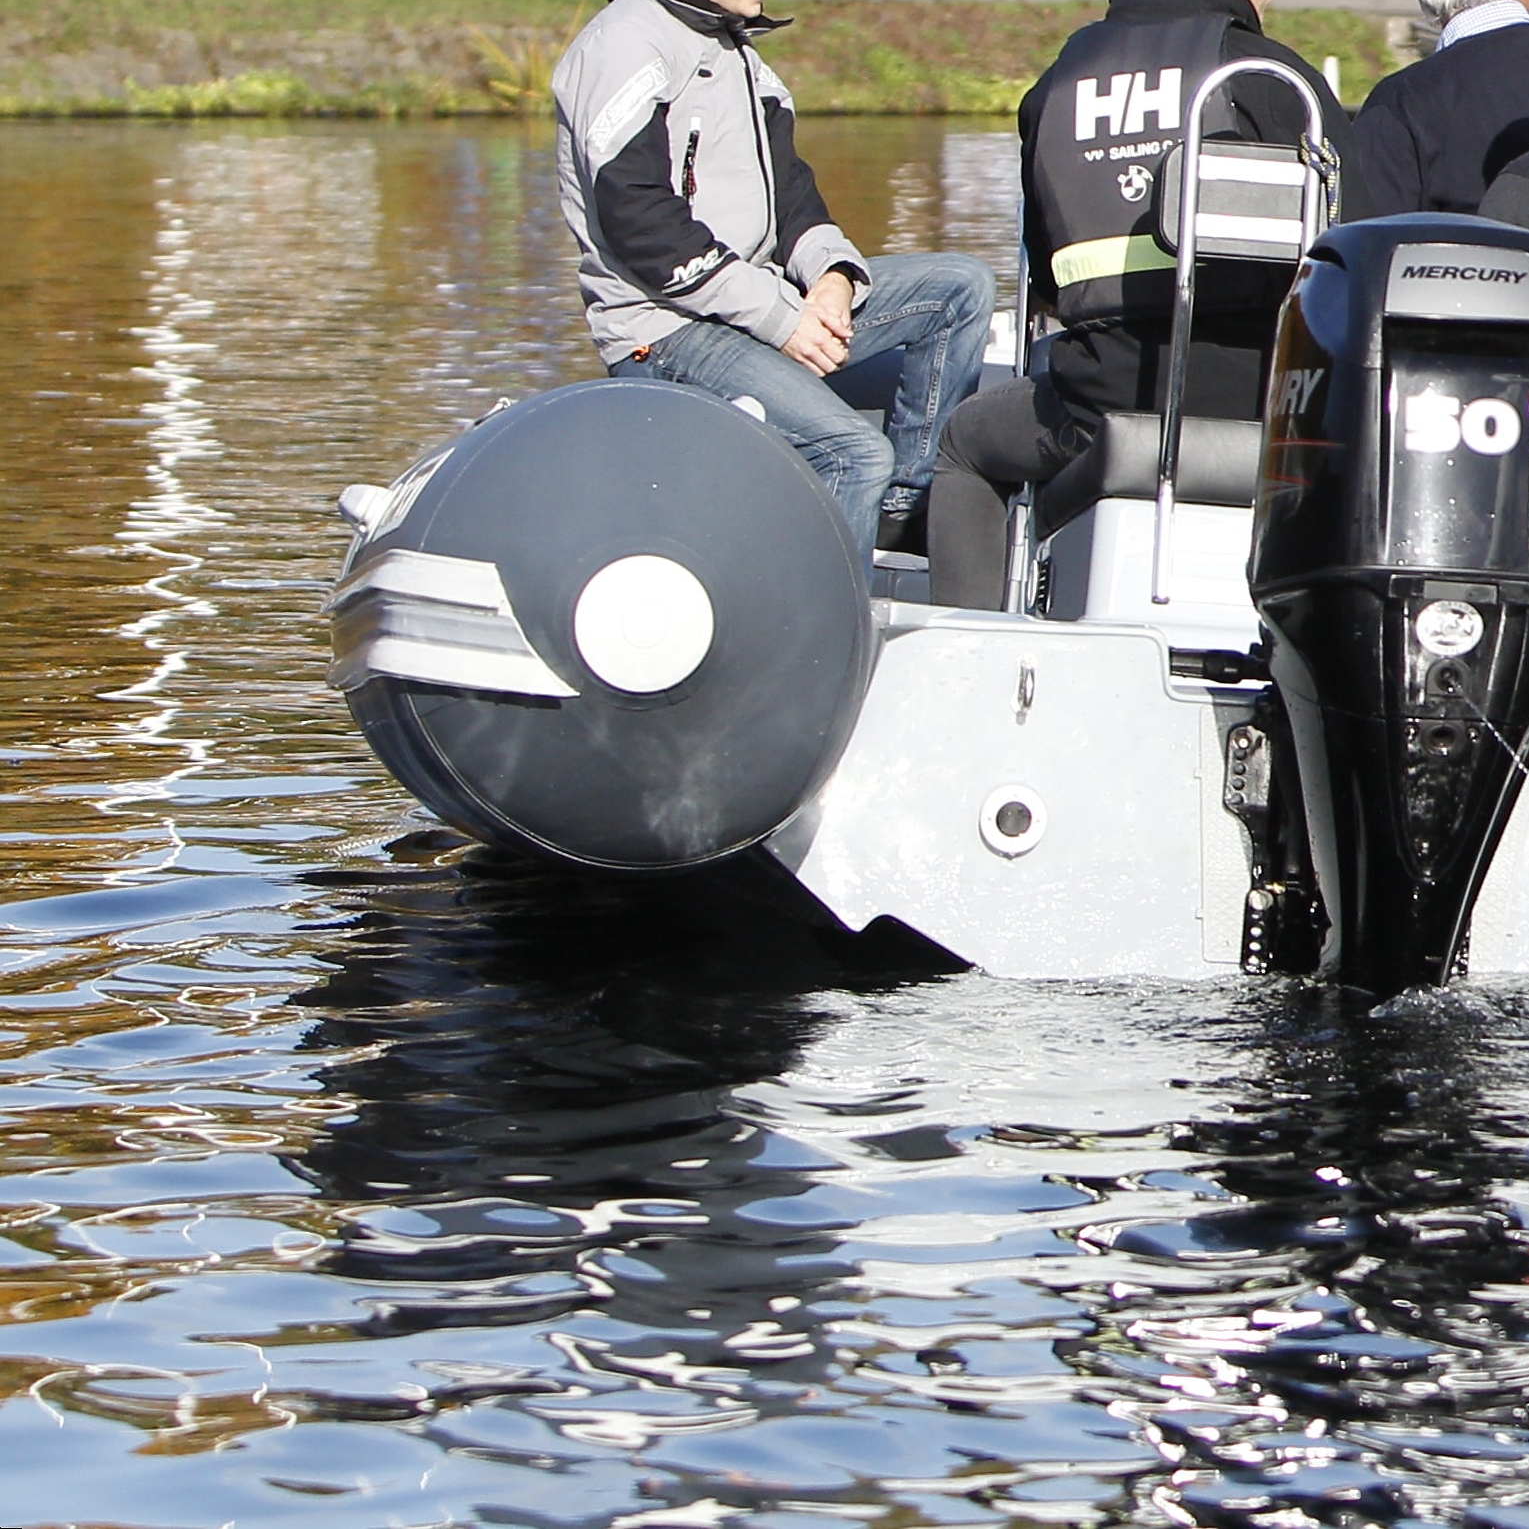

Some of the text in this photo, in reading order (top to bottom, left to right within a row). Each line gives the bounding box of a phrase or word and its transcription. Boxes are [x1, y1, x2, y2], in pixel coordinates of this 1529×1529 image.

[1074, 67, 1183, 142] HH
[1109, 141, 1161, 160] SAILING
[1401, 265, 1529, 284] MERCURY
